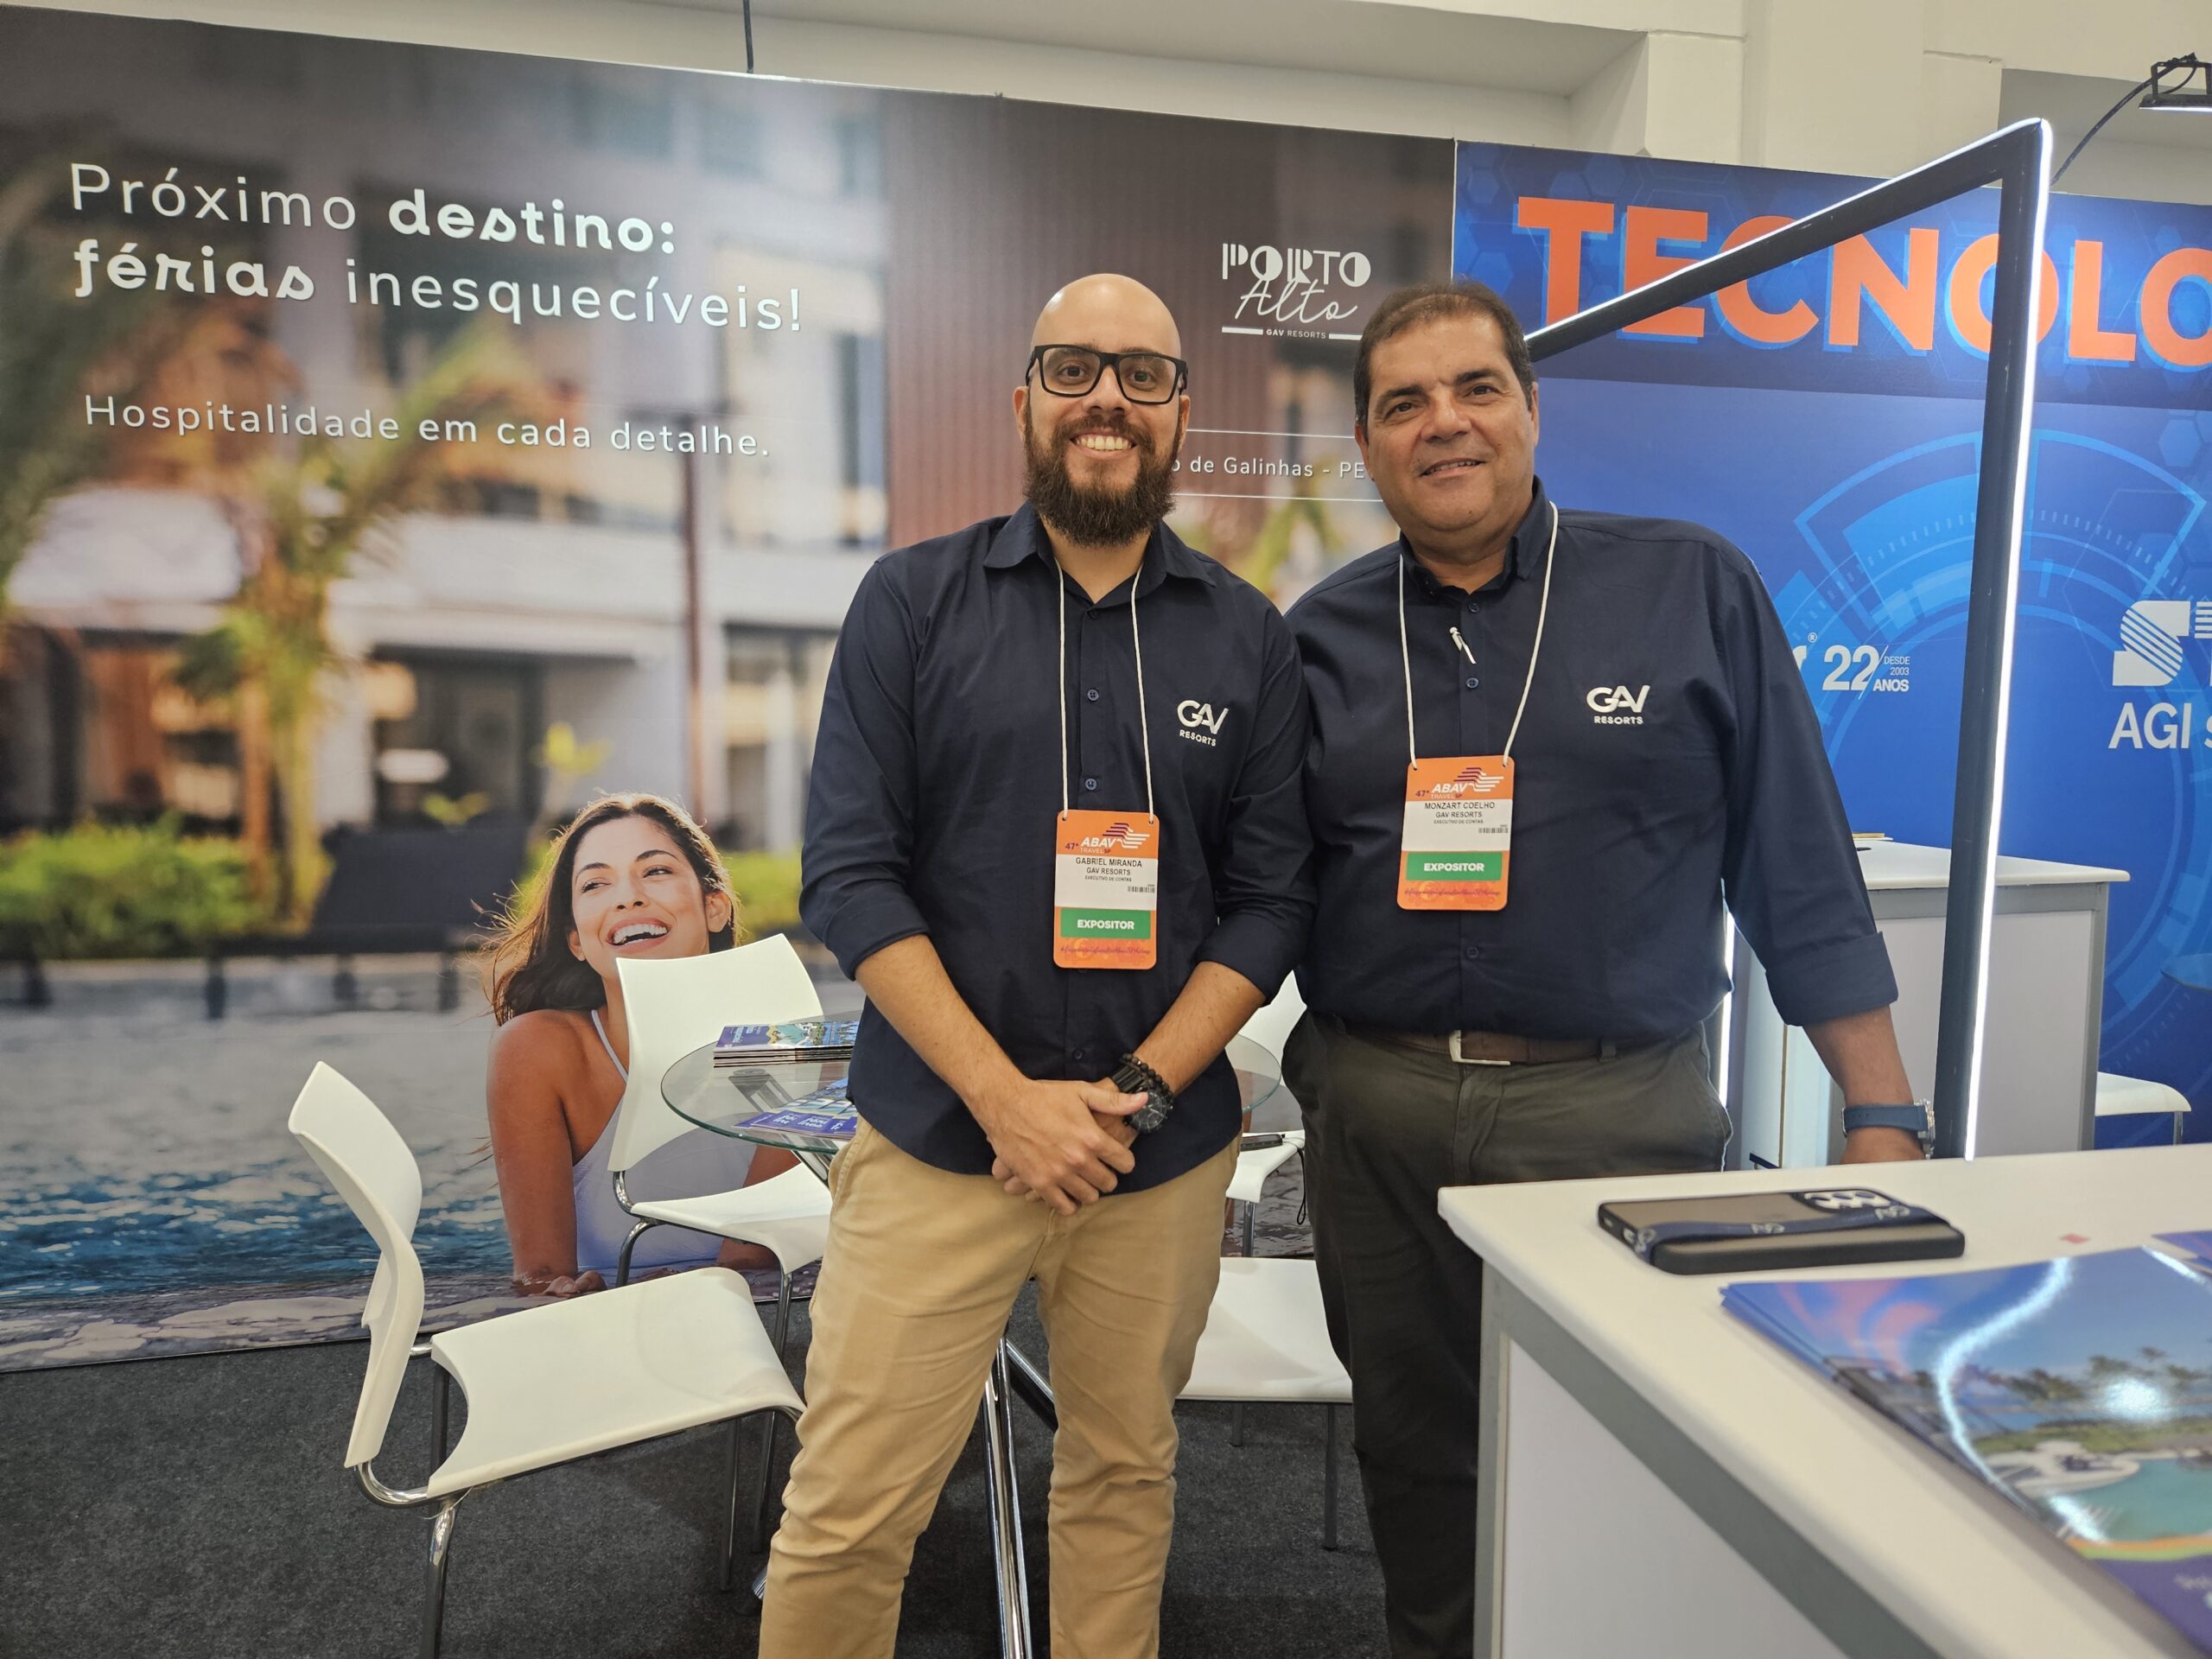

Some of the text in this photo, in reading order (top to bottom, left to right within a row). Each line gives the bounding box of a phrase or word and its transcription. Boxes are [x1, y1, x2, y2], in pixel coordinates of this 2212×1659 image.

[71, 162, 676, 255] Próximo destino:
[1222, 243, 1371, 288] PORTO
[73, 238, 802, 332] férias inesquecíveis!
[1234, 275, 1358, 324] Alto
[1266, 328, 1326, 339] GAV RESORTS
[85, 394, 771, 458] Hospitalidade em cada detalhe.
[1190, 456, 1215, 473] de
[1224, 457, 1313, 477] Galinhas
[1339, 461, 1365, 479] PE
[1822, 645, 1880, 691] 22
[1884, 656, 1910, 665] DESDE
[1890, 666, 1910, 676] 2003
[1872, 679, 1910, 692] ANOS
[1586, 685, 1650, 713] GAV
[1178, 700, 1229, 734] GAV
[1593, 715, 1643, 725] RESORTS
[2107, 702, 2192, 749] AGI
[1179, 729, 1217, 747] RESORTS
[1431, 783, 1468, 793] ABAV
[1080, 836, 1116, 849] ABAV
[1076, 857, 1142, 868] GABRIEL MIRANDA
[1424, 862, 1484, 873] EXPOSITOR
[1077, 919, 1135, 931] EXPOSITOR
